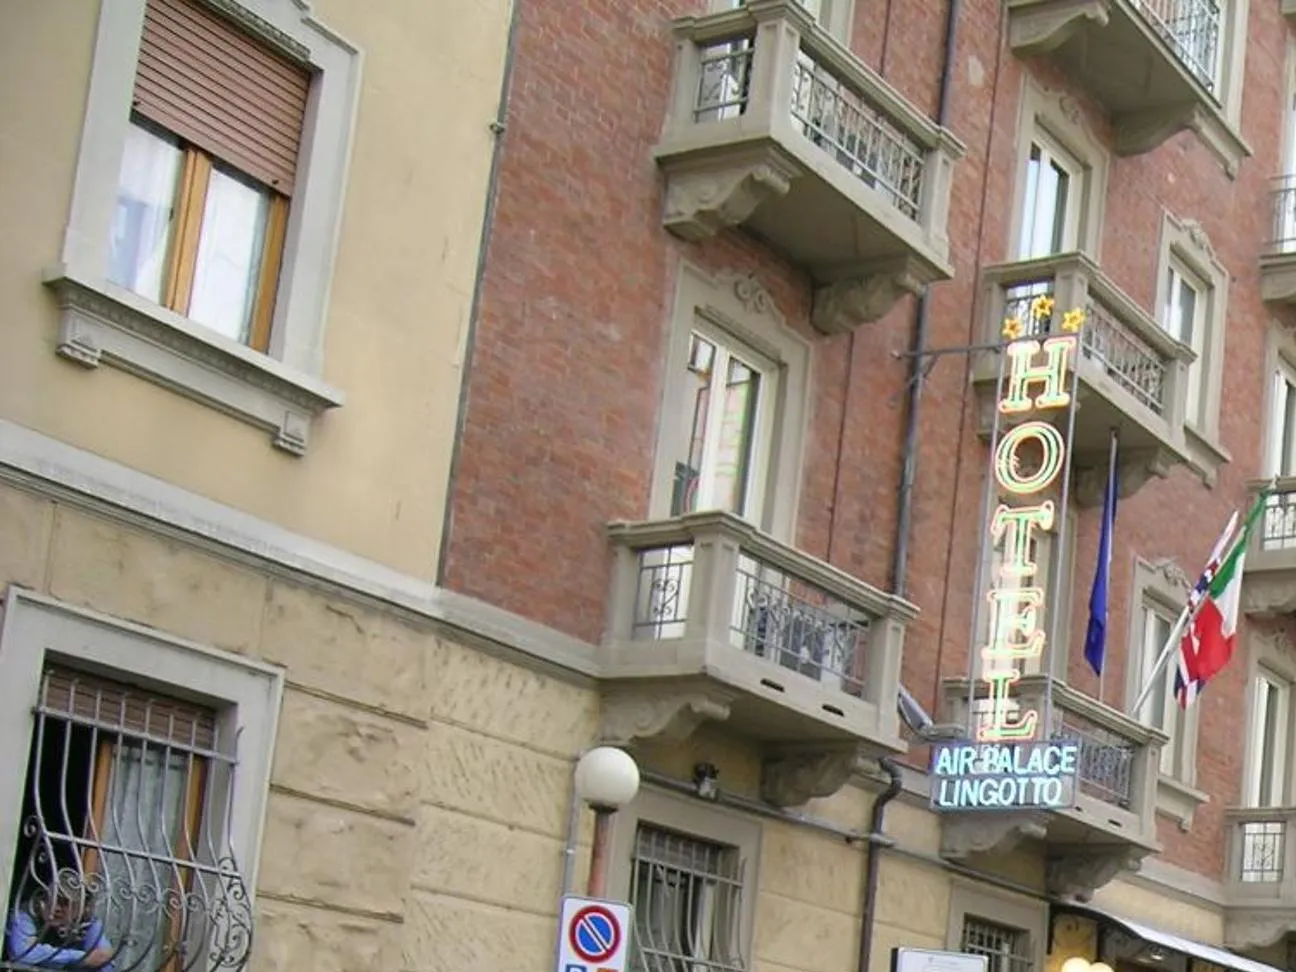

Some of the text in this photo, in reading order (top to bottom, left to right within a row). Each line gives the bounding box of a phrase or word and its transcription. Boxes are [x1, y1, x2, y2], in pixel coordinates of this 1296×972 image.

[976, 335, 1077, 742] HOTEL
[935, 746, 1078, 775] AIR PALACE
[939, 777, 1062, 807] LINGOTTO
